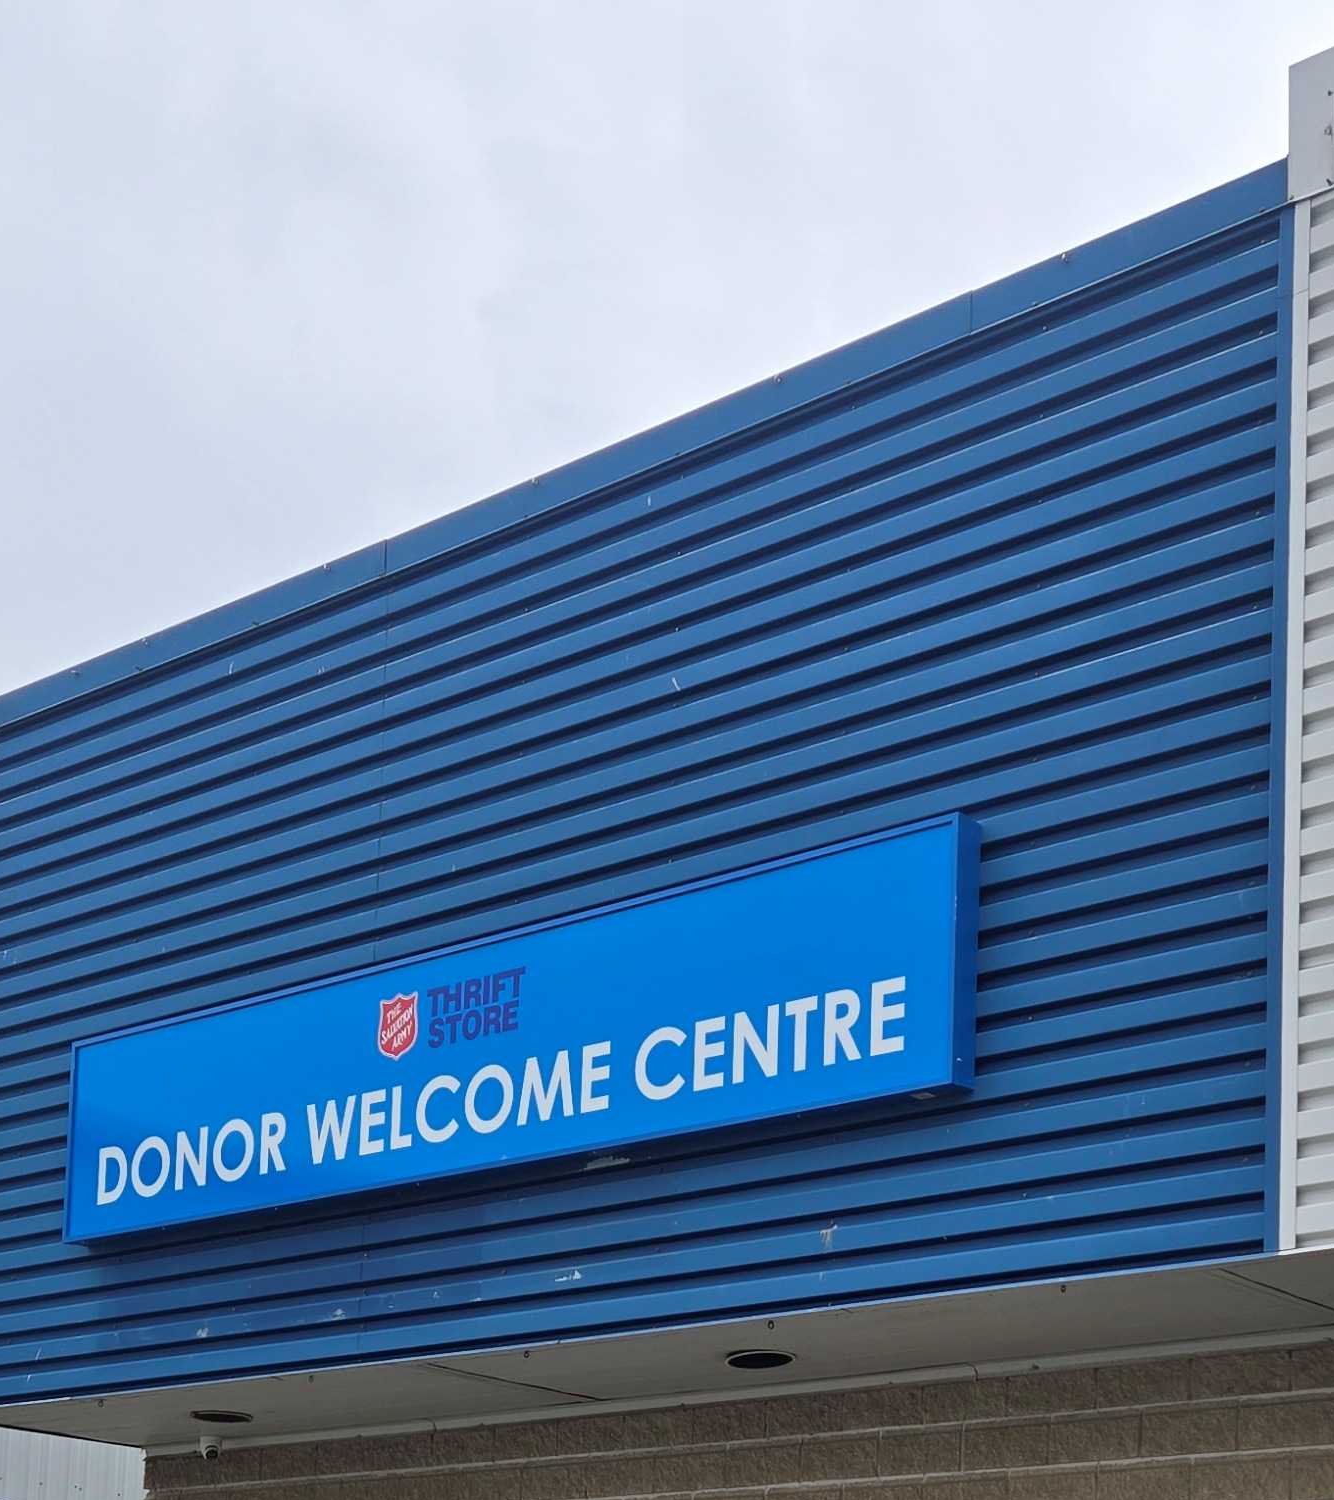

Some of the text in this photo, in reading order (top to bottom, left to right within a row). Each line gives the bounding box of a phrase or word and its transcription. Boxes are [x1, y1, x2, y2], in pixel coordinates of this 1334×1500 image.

[386, 1002, 403, 1025] THE
[427, 966, 526, 1017] THRIFT
[380, 1004, 414, 1045] SALVATION
[391, 1021, 413, 1051] ARMY
[428, 1000, 518, 1048] STORE
[97, 975, 907, 1206] DONOR WELCOME CENTRE
